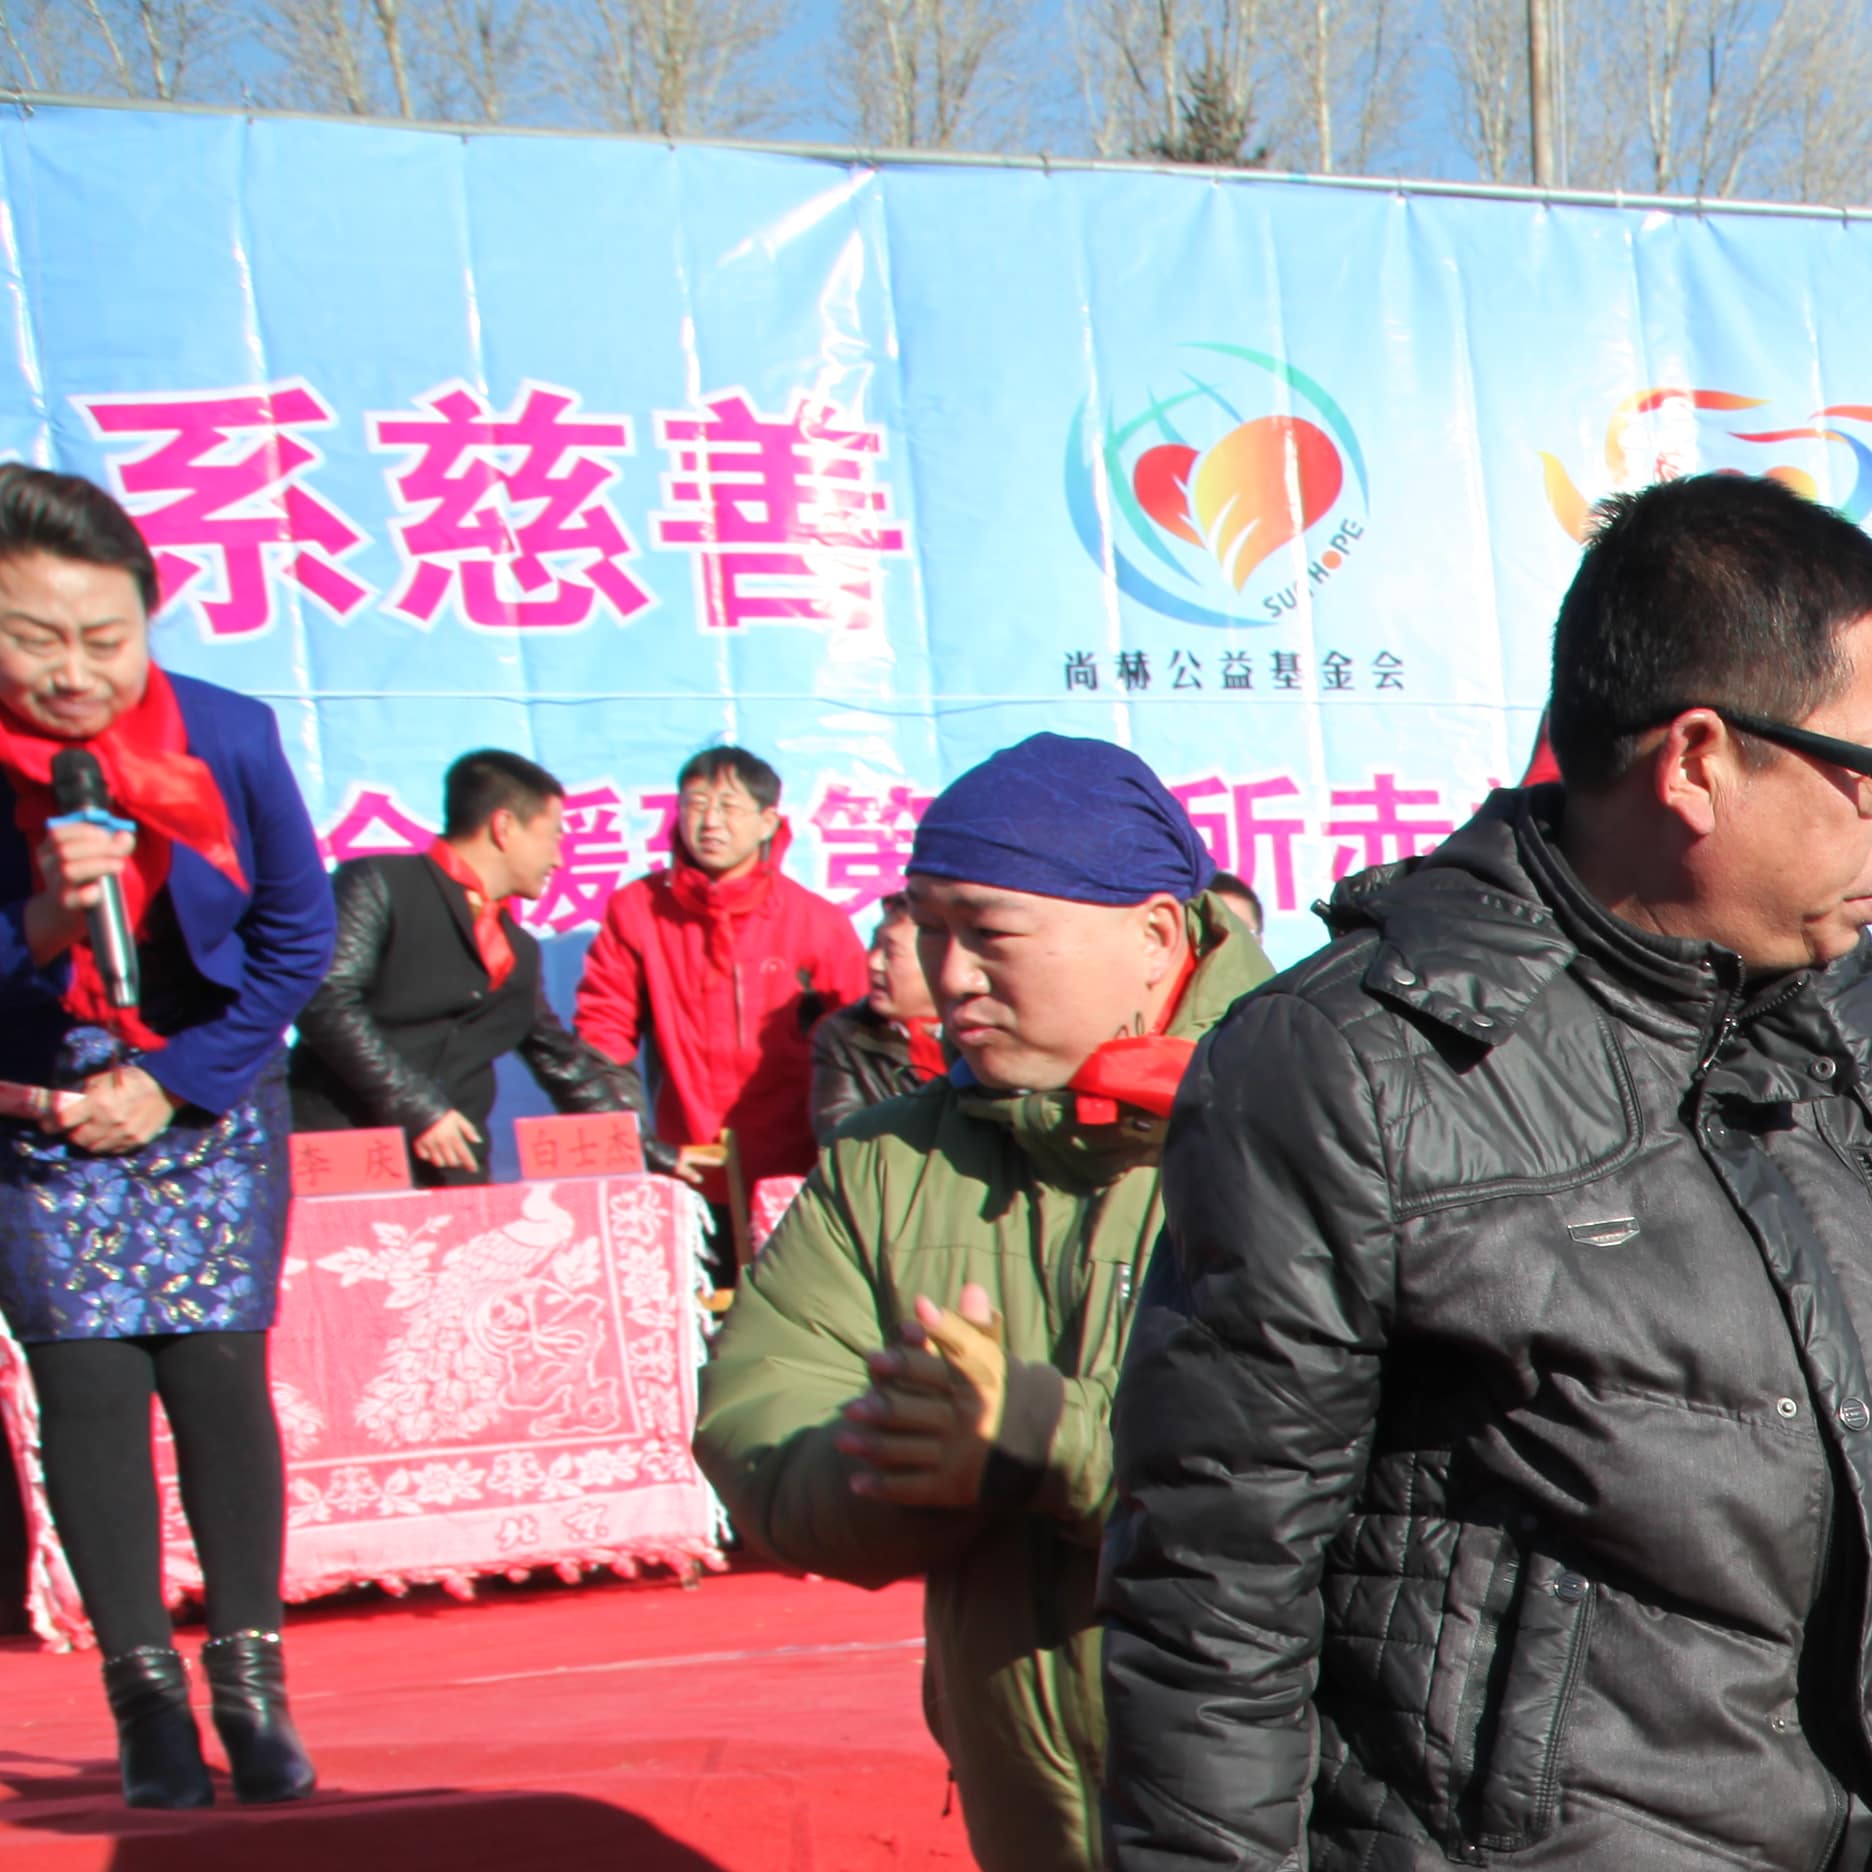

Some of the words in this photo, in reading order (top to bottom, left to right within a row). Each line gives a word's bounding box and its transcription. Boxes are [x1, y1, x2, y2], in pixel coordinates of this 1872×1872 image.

[85, 387, 907, 635] 系慈善
[1308, 517, 1365, 586] HOPE
[1064, 649, 1405, 691] 尚赫公益基金会
